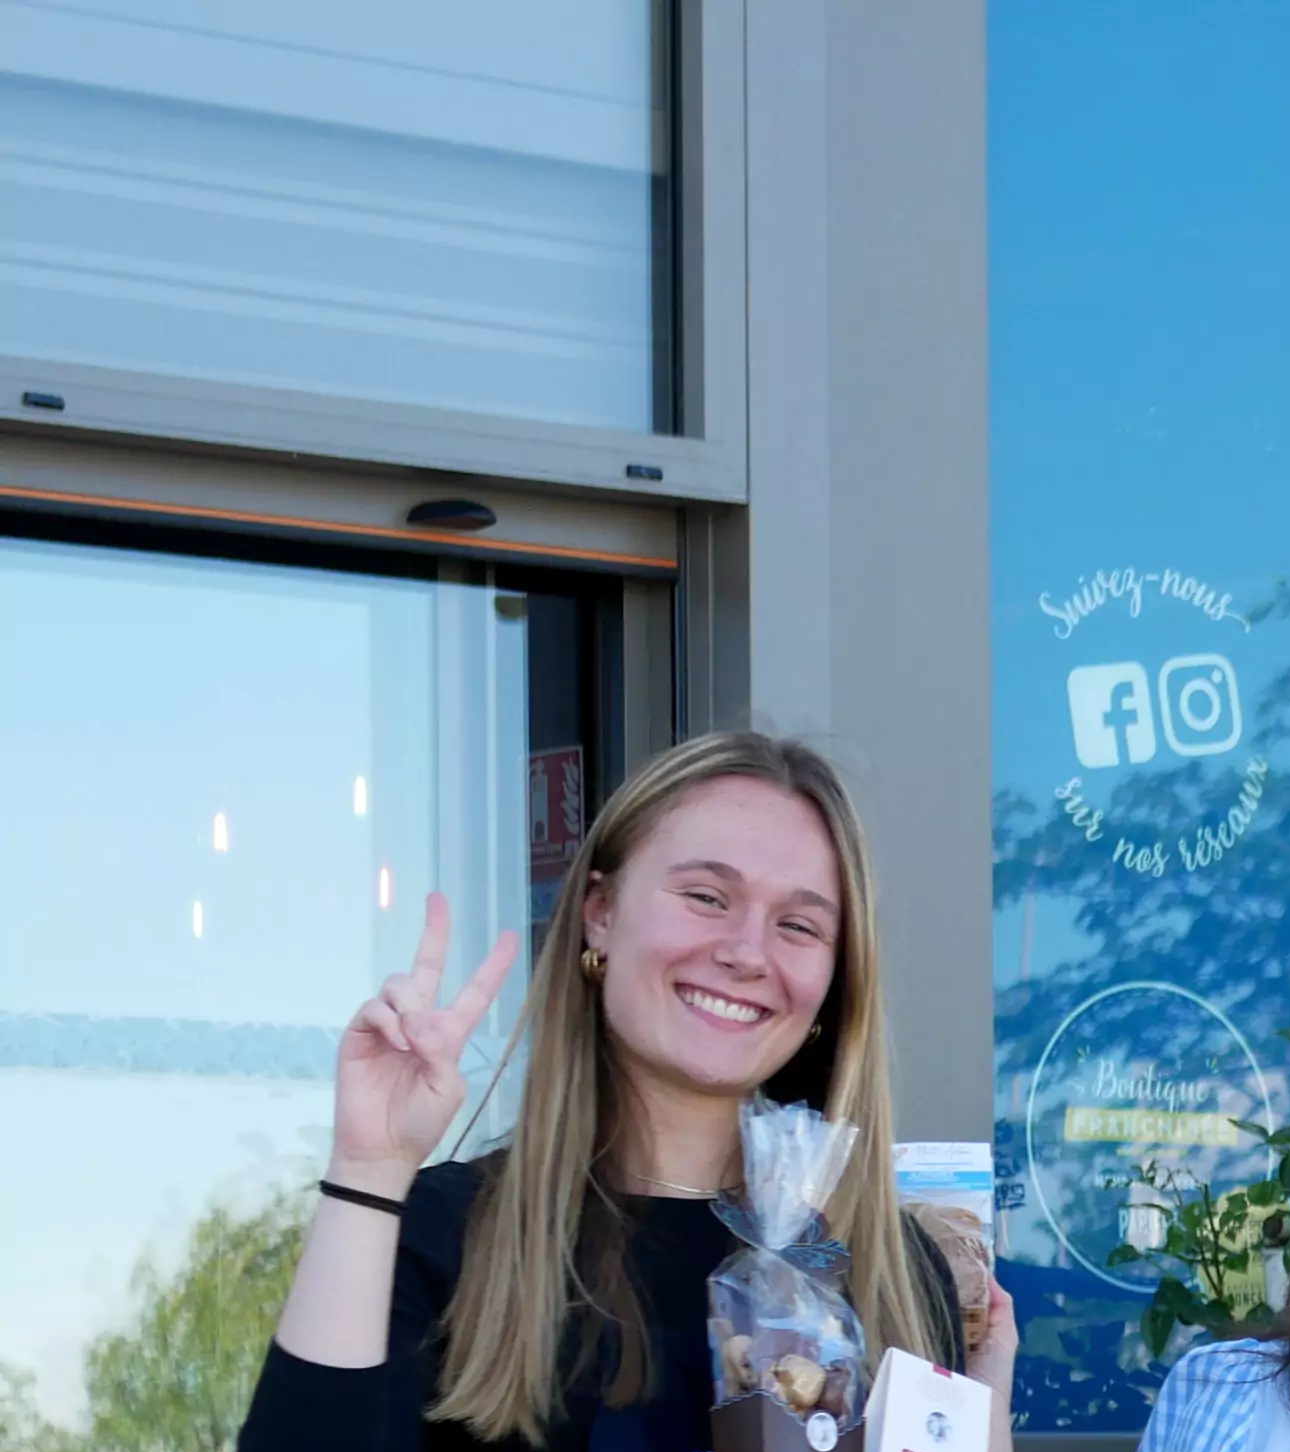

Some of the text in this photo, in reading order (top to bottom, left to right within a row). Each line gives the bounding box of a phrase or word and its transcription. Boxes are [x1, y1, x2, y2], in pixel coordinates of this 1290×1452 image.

[1039, 566, 1251, 639] Suivez-nous
[1055, 755, 1268, 878] sur nos réseaux
[1094, 1058, 1211, 1113] Boutique
